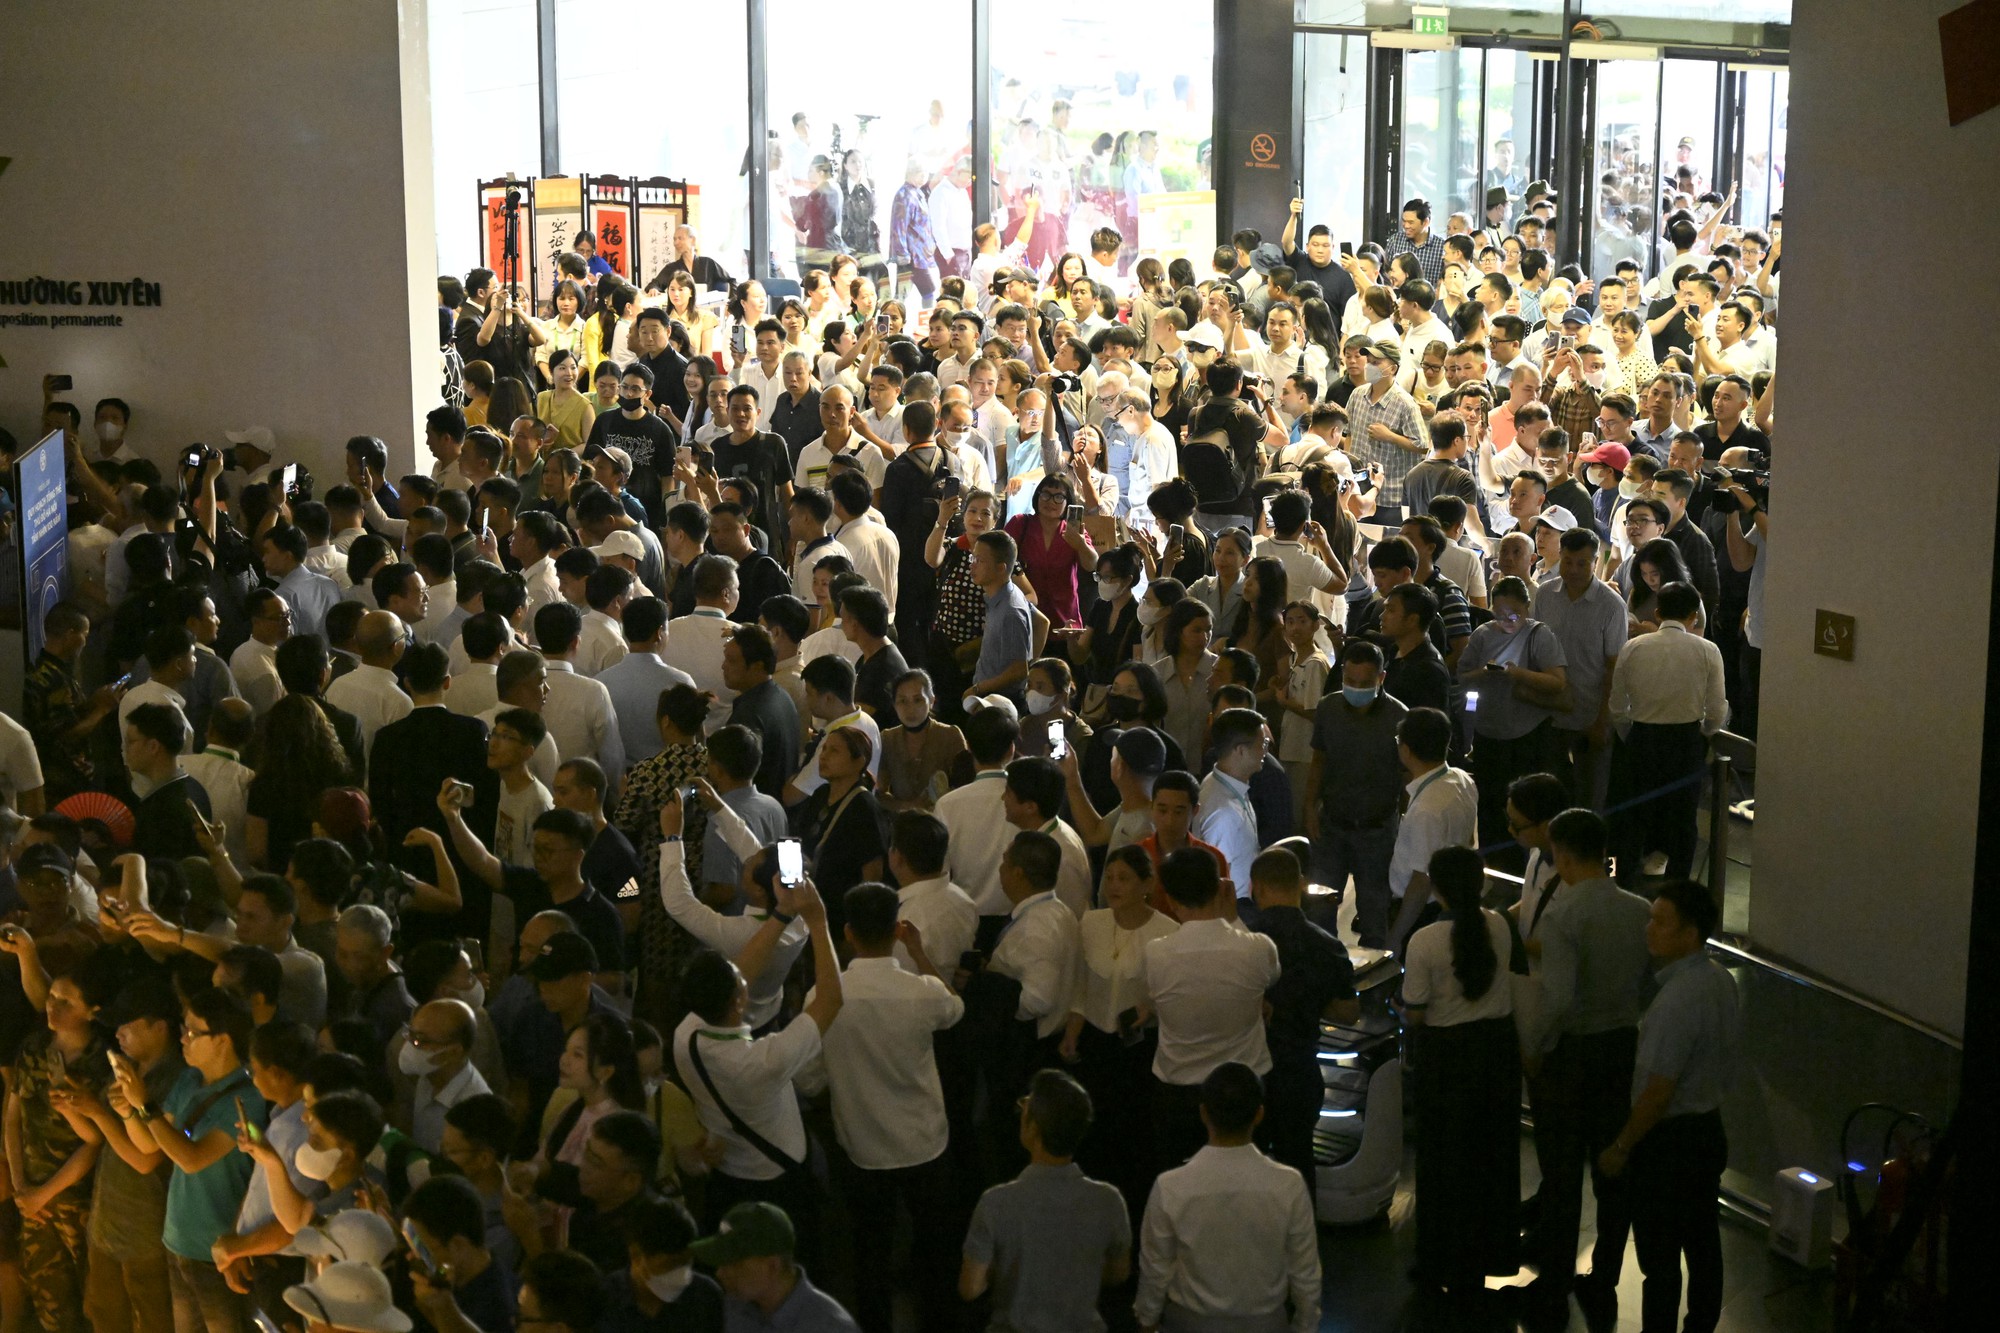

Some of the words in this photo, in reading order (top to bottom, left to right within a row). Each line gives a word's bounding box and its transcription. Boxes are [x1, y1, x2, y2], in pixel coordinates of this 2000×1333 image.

[0, 276, 82, 306] HƯỜNG
[87, 277, 161, 306] XUYÊN
[51, 314, 123, 329] permanente
[617, 889, 640, 898] adidas
